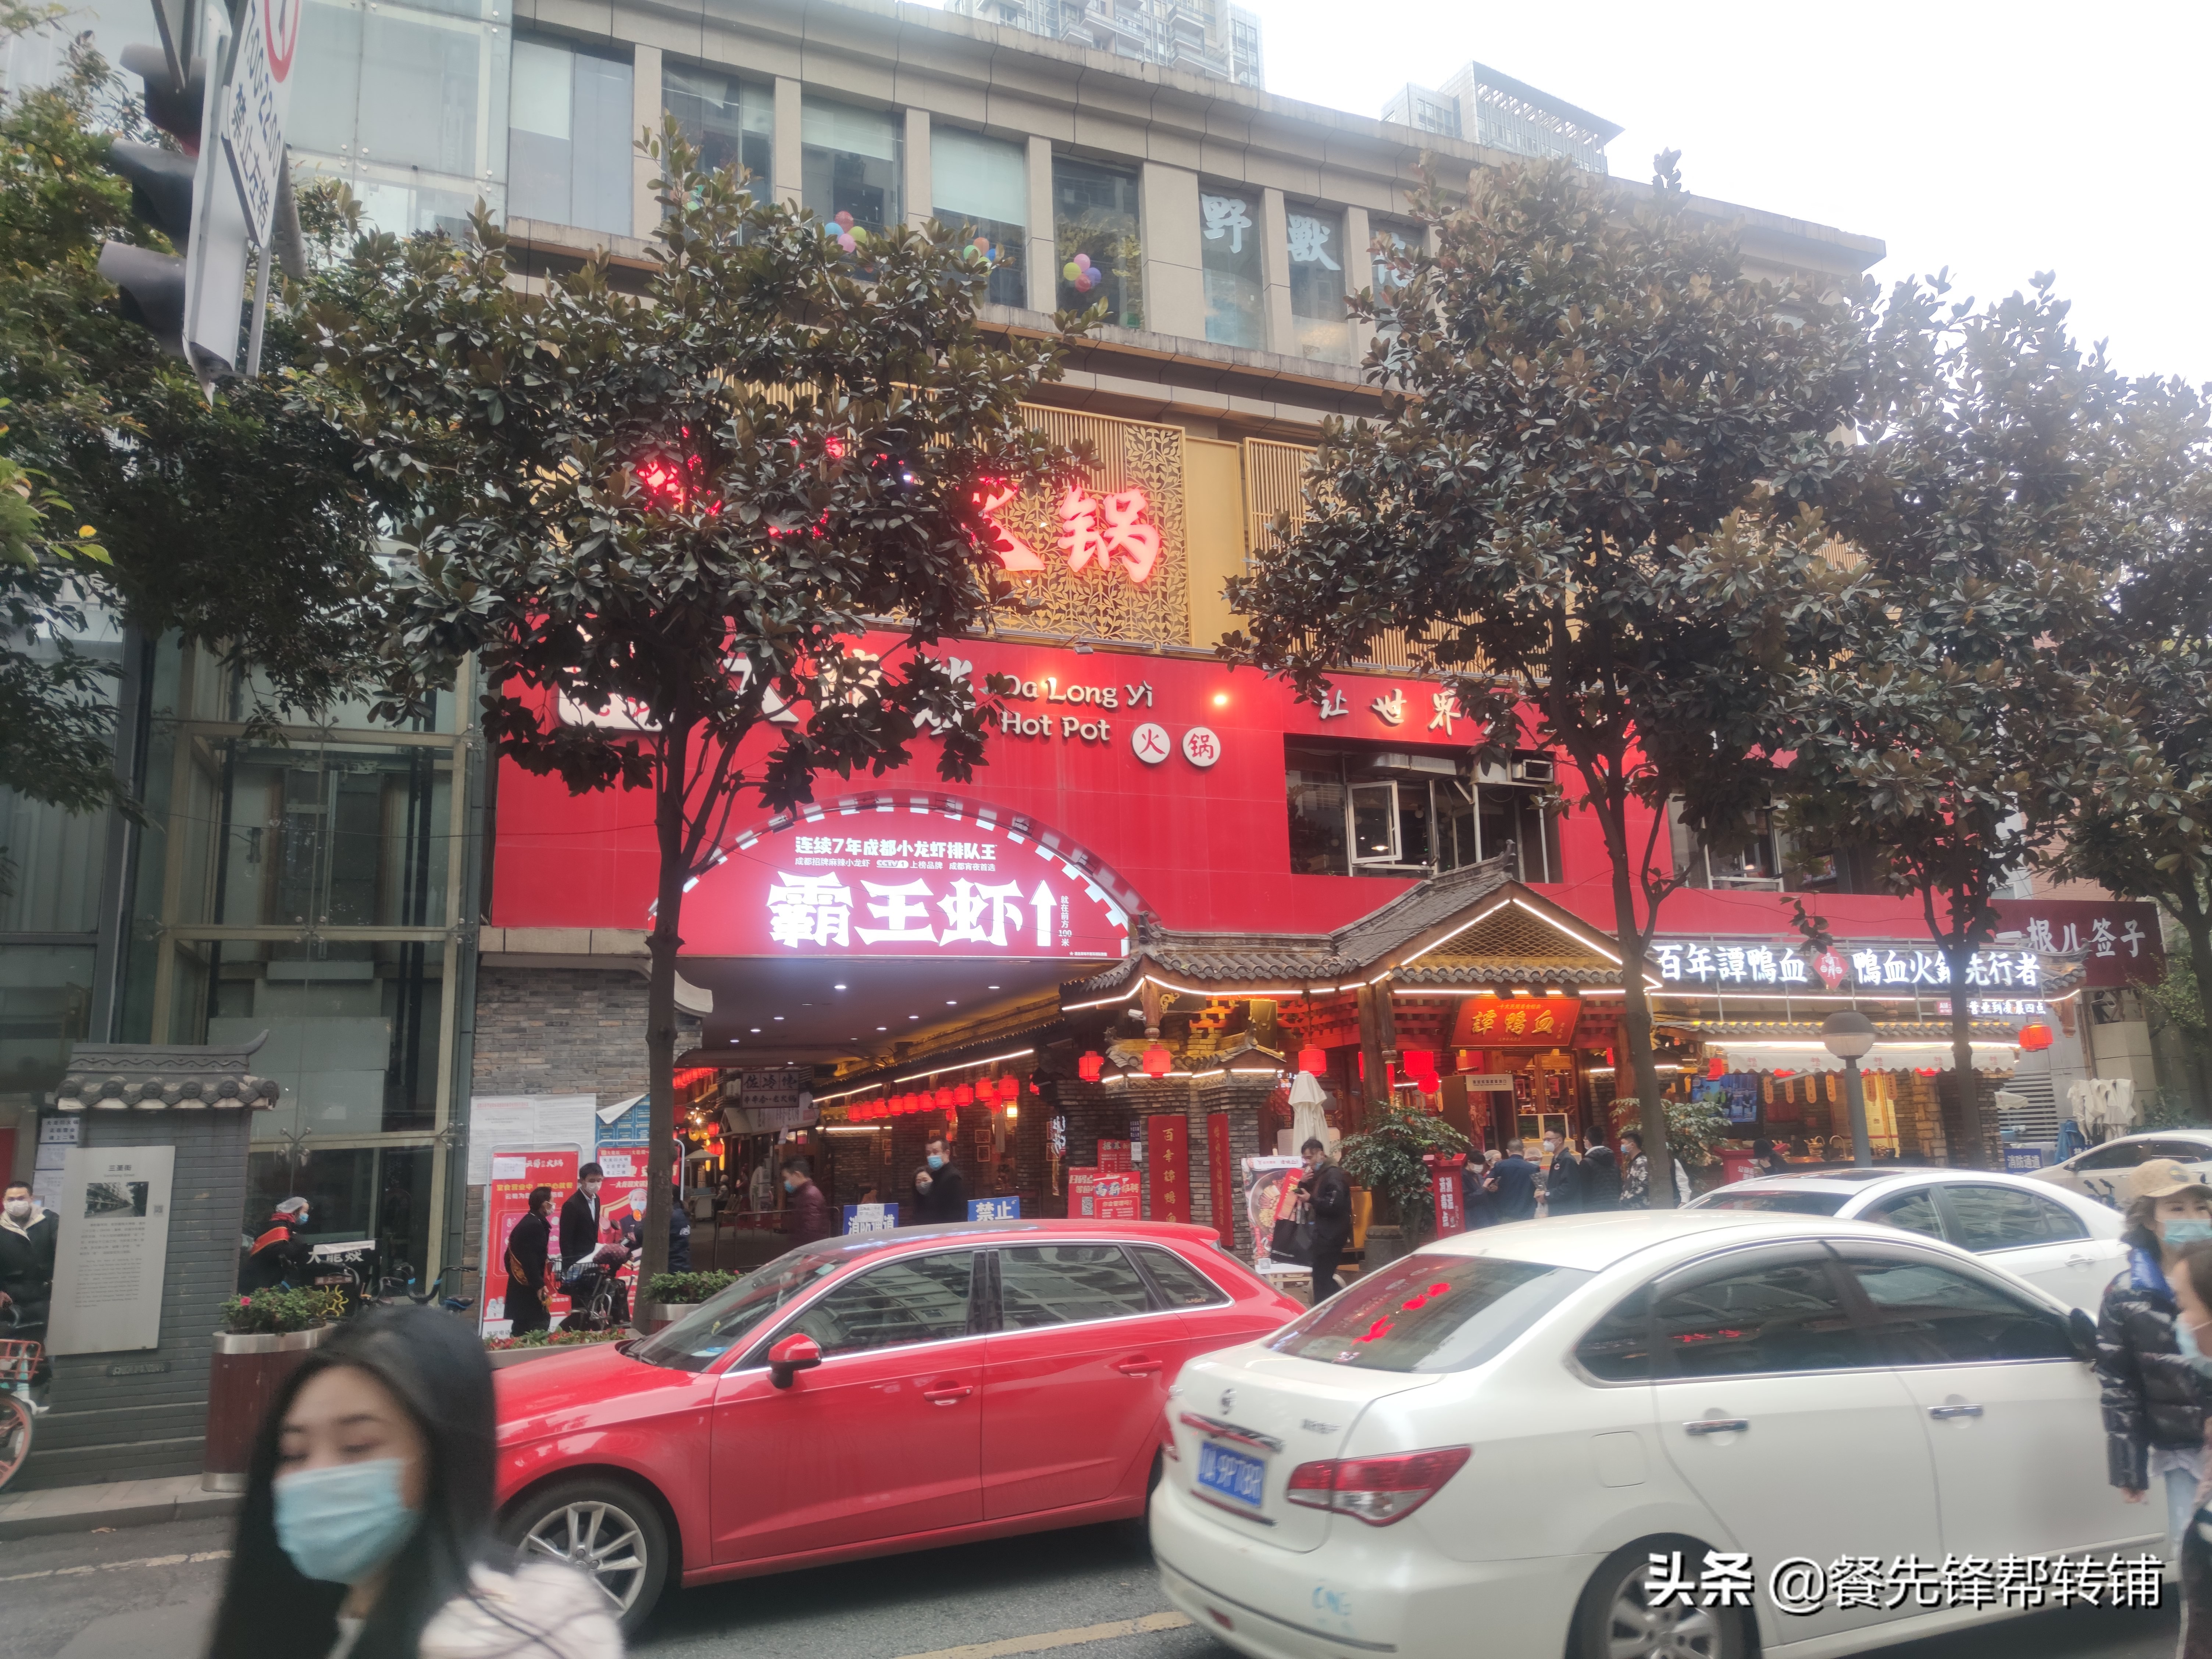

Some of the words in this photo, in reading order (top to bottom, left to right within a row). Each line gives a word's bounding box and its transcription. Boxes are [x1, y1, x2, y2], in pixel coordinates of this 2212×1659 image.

[232, 81, 269, 238] 禁止左转
[1048, 678, 1118, 708] Long
[1000, 711, 1053, 736] Hot
[1062, 716, 1111, 741] Pot
[1139, 729, 1214, 760] 火锅
[795, 836, 996, 860] 连续7年成都小龙虾排队王
[795, 857, 871, 867] 成都招牌麻辣小龙虾
[910, 861, 943, 870] 上榜品牌
[949, 861, 996, 872] 成都宵夜首选
[766, 871, 1024, 948] 霸王虾
[1996, 917, 2145, 957] 一根儿签子
[1652, 943, 1808, 984] 百年譚鴨血
[2007, 1155, 2041, 1169] 消防通道
[975, 1200, 1014, 1221] 禁止
